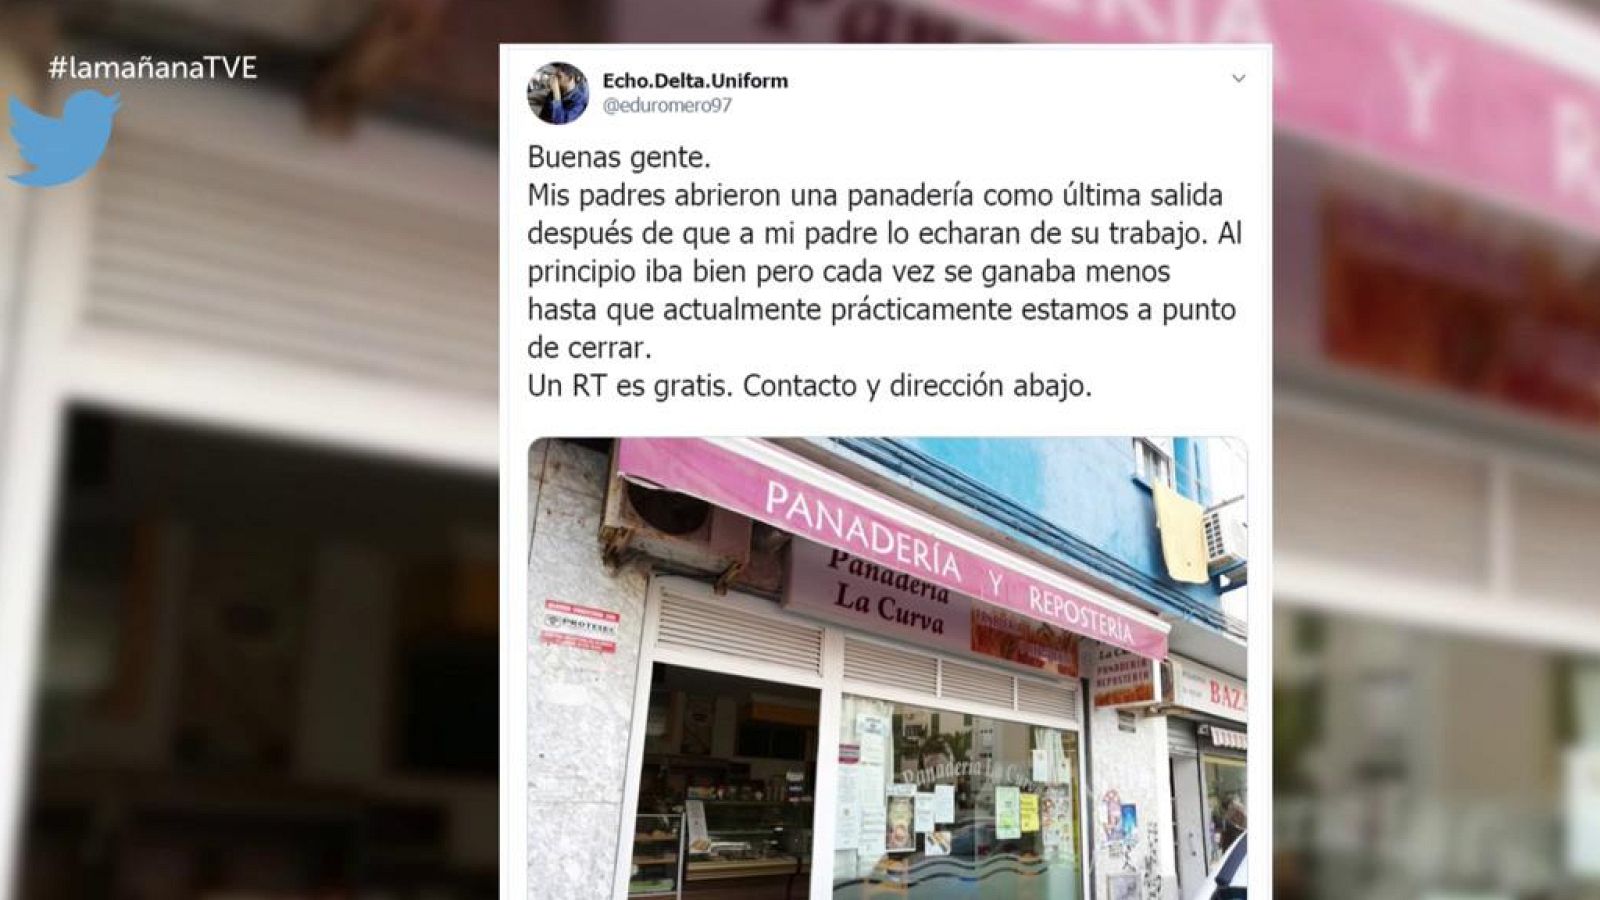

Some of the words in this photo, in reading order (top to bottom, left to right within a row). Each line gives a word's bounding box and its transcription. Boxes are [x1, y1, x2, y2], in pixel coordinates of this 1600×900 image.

[766, 480, 961, 583] PANADERÍA
[989, 569, 1003, 596] Y
[834, 581, 870, 613] La
[878, 596, 944, 634] Curva
